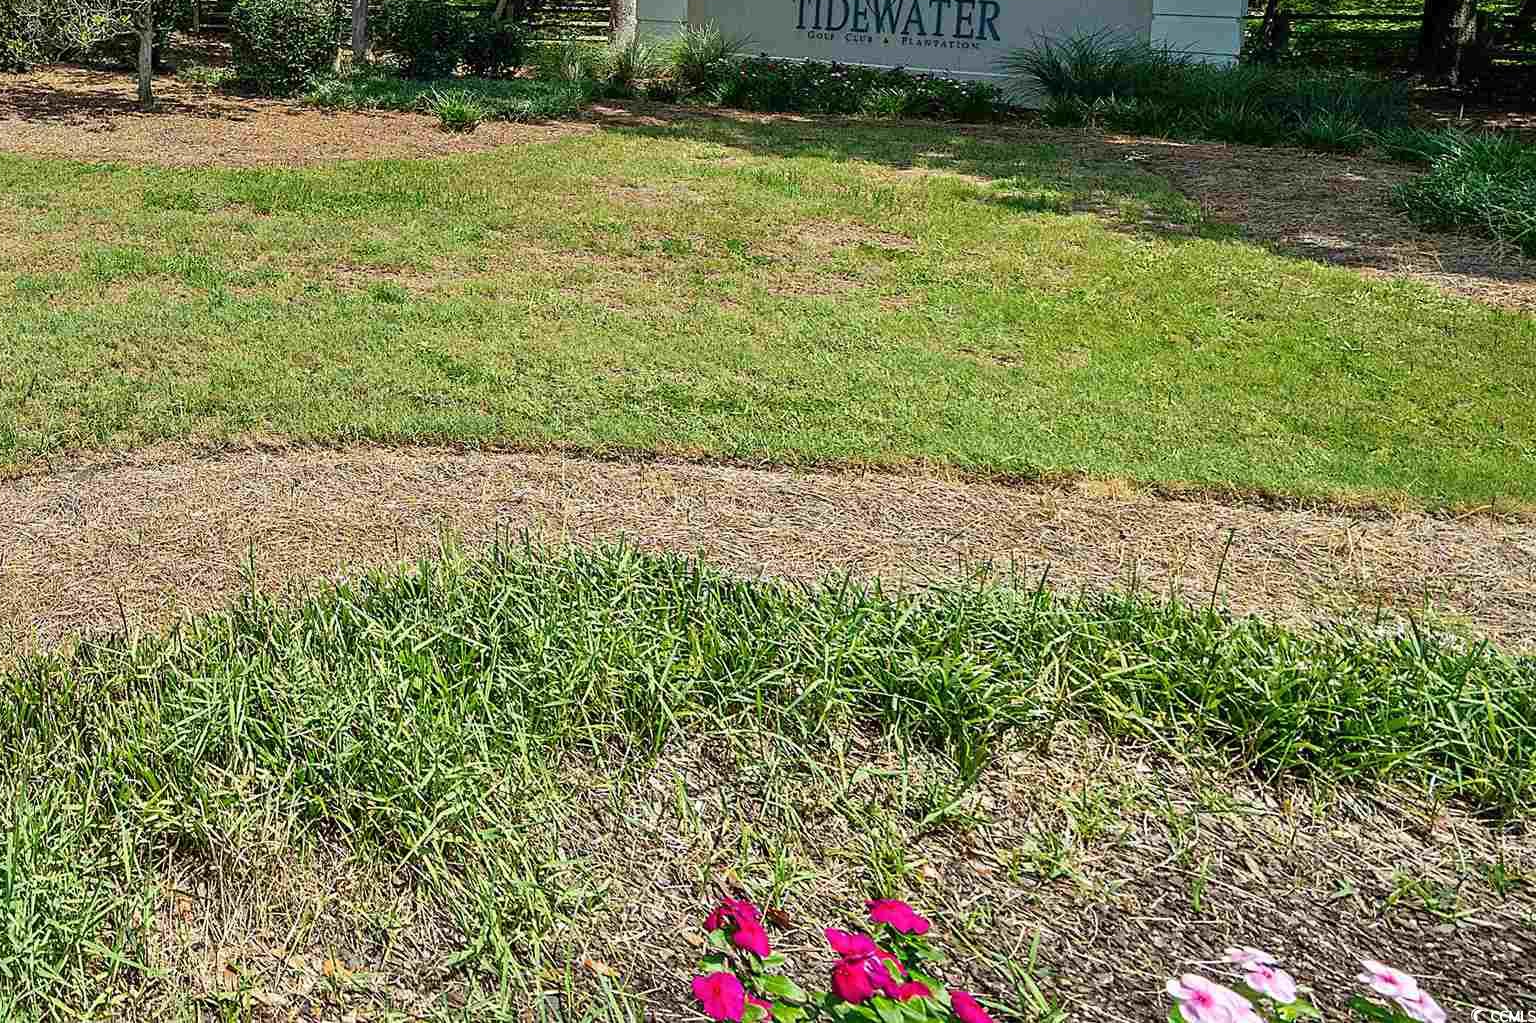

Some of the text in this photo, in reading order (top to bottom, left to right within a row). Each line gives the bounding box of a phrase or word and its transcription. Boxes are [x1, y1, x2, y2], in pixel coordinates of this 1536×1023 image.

[807, 30, 835, 41] GOLF
[844, 32, 874, 44] CLUB
[901, 36, 981, 50] PLANTATION
